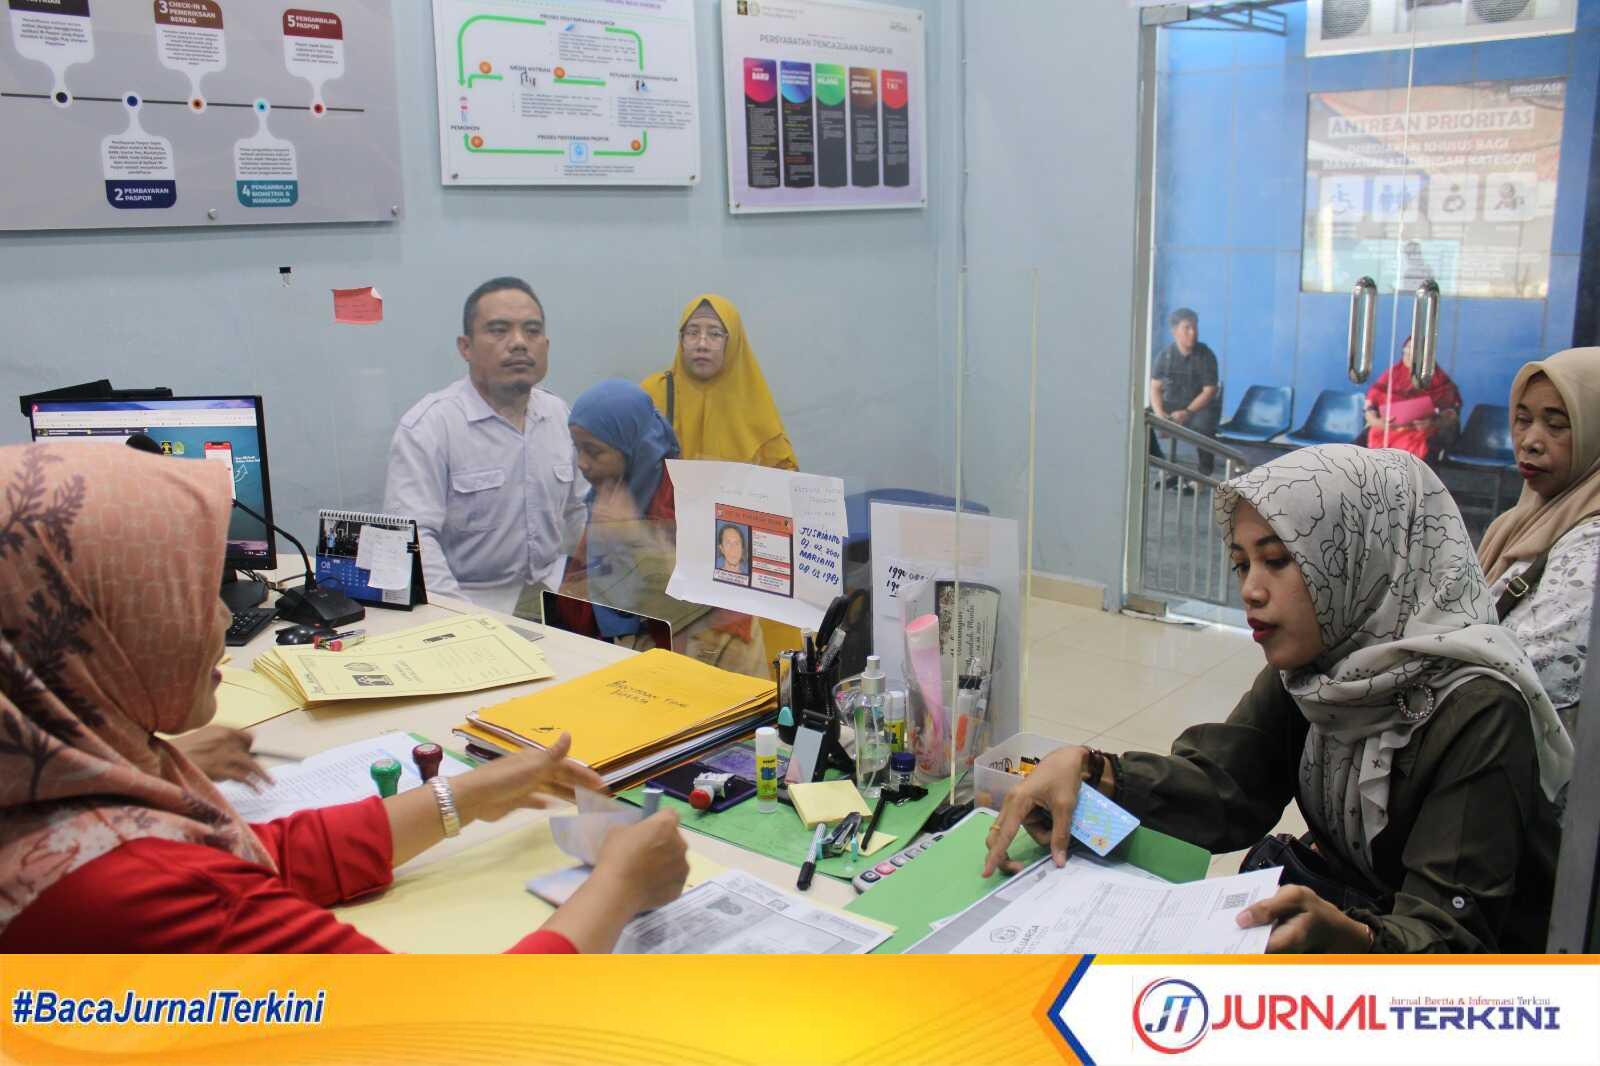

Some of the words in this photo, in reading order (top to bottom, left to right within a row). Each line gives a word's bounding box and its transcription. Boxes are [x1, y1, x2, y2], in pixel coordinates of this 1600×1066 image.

[159, 0, 169, 14] 3
[169, 0, 199, 11] CHECK-IN
[169, 9, 216, 18] PEMERIKSAAN
[170, 16, 197, 24] BERKAS
[287, 15, 296, 27] 5
[295, 16, 337, 25] PENGAMBILAN
[295, 22, 320, 30] PASPOR
[759, 34, 812, 47] PERSYARATAN
[813, 39, 858, 51] PENGAJUAN
[1332, 115, 1421, 135] ANTREAN
[1427, 108, 1533, 131] PRIORITAS
[114, 188, 124, 201] 2
[241, 185, 250, 197] 4
[800, 550, 835, 569] MARIANA
